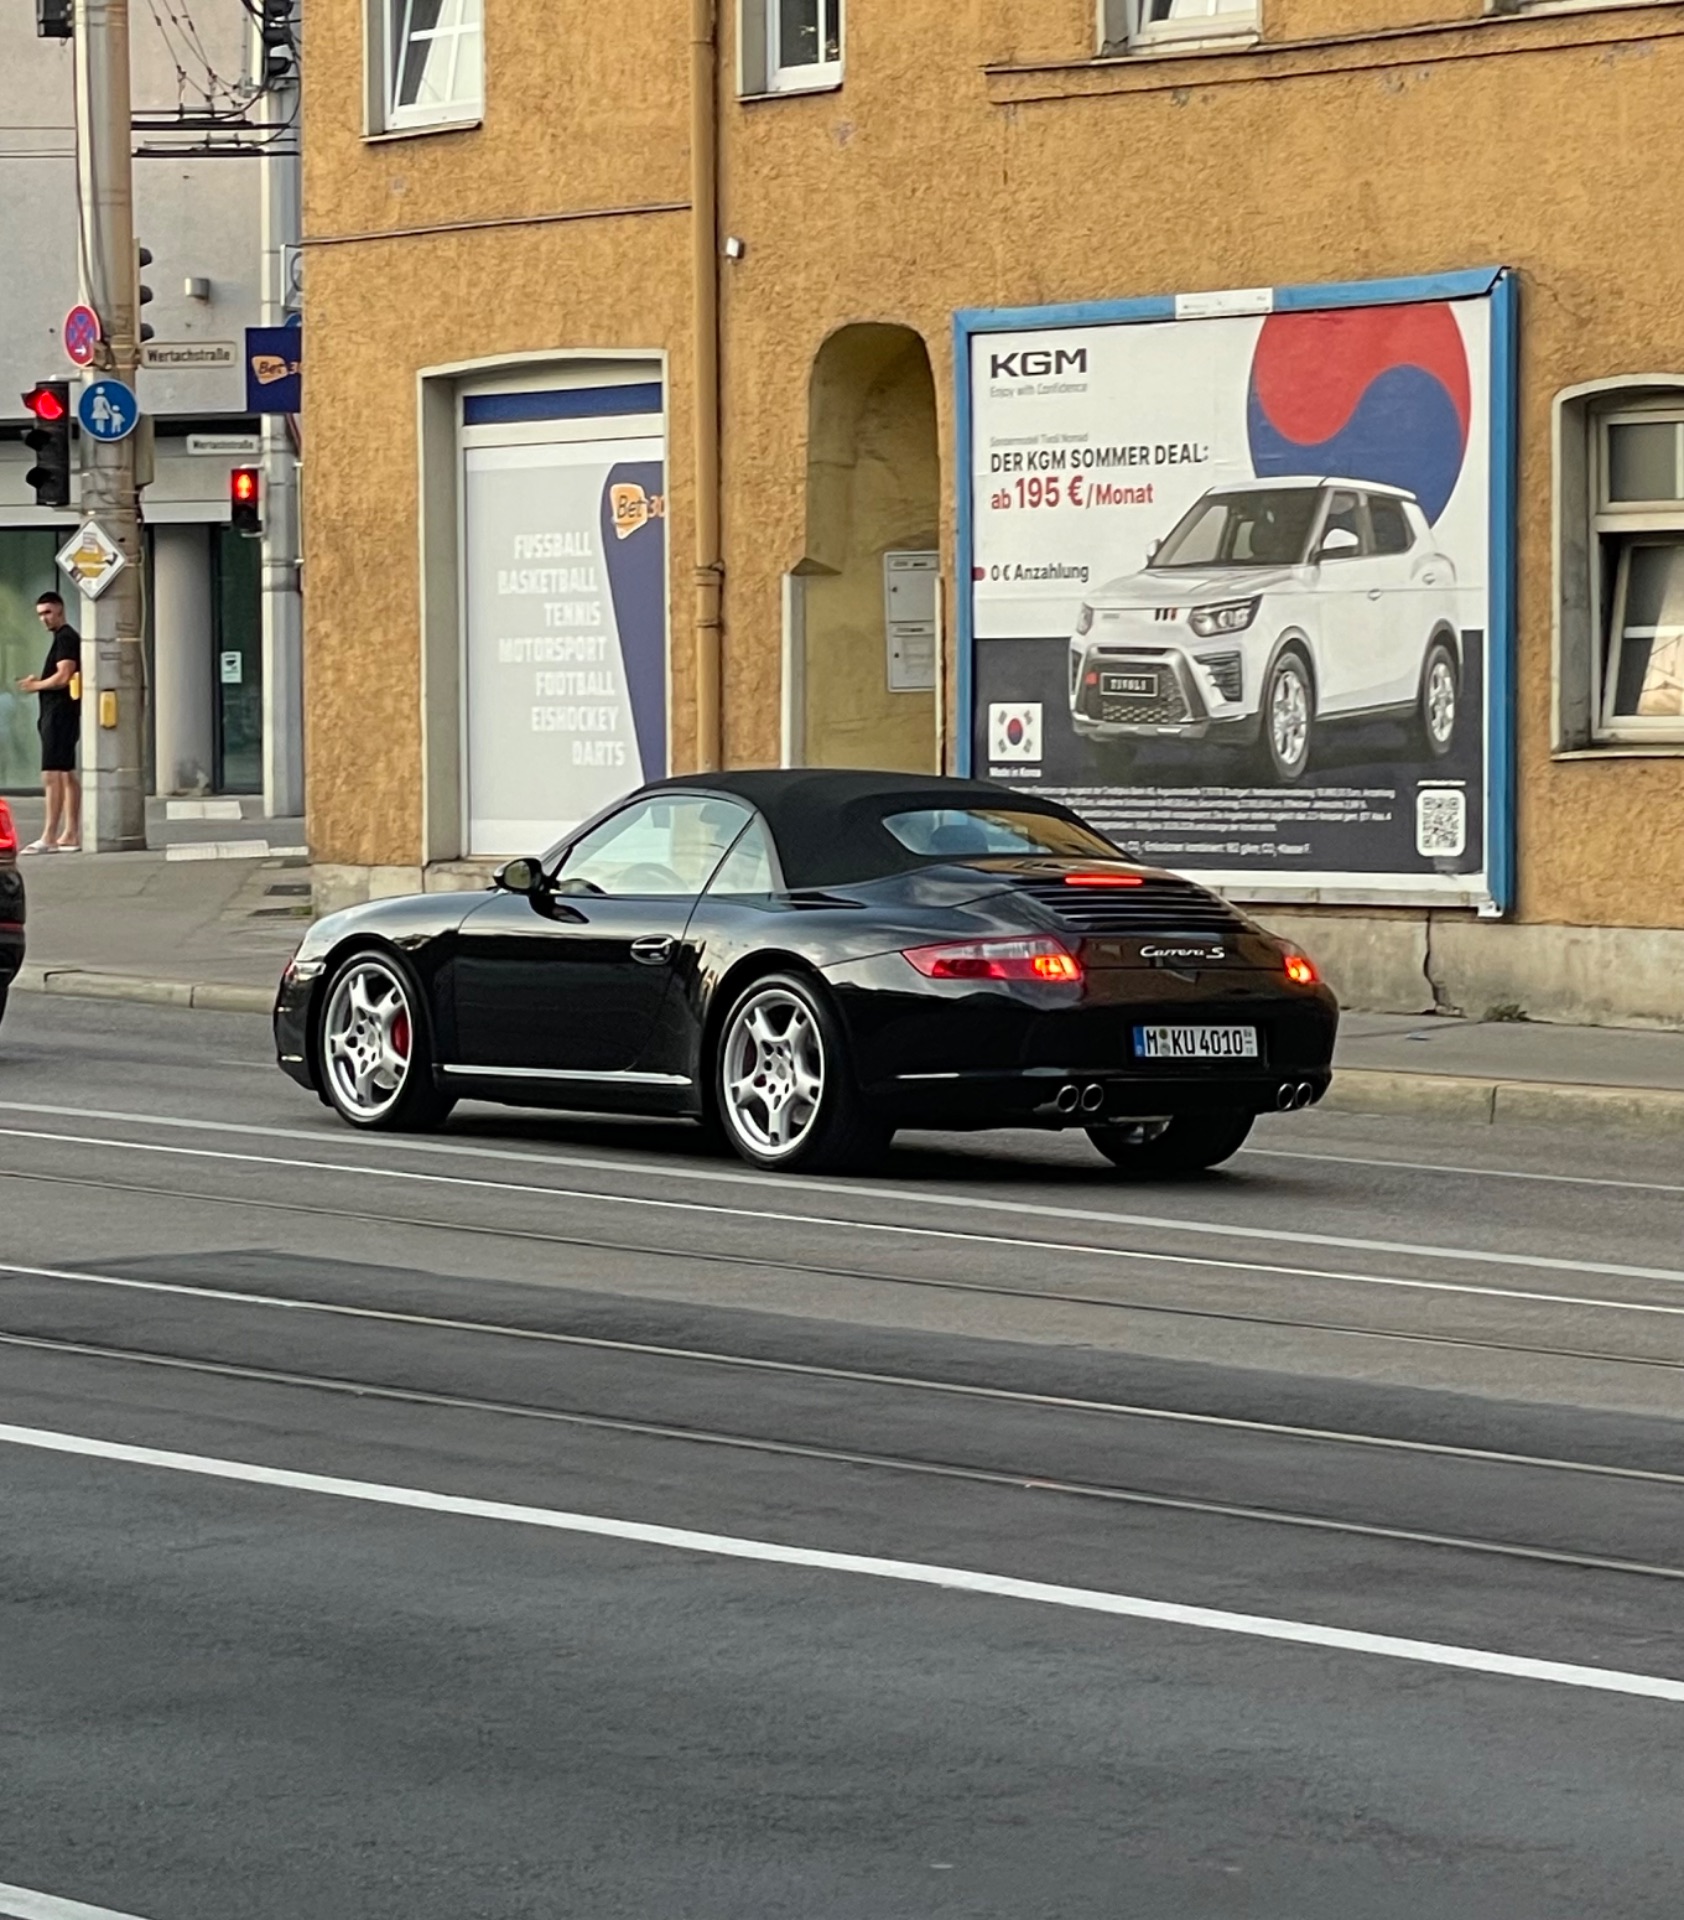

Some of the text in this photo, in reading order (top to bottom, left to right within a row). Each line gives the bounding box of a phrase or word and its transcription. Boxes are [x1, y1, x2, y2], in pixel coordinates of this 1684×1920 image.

[148, 347, 230, 362] Wertachstraße
[990, 347, 1087, 379] KGM
[991, 443, 1209, 473] DER KGM SOMMER DEAL:
[991, 488, 1011, 510] ab
[1015, 476, 1060, 509] 195
[514, 531, 592, 560] FUSSBALL
[498, 567, 598, 594] BASKETBALL
[991, 565, 999, 581] 0
[1014, 563, 1089, 582] Anzahlung
[544, 601, 600, 627] TENNIS
[499, 635, 607, 663] MOTORSPORT
[536, 670, 616, 696] FOOTBALL
[531, 705, 619, 732] EISHOCKEY
[572, 740, 625, 766] DARTS
[1140, 945, 1225, 959] Carrera S
[1146, 1029, 1159, 1055] M
[1171, 1029, 1196, 1055] KU
[1199, 1029, 1243, 1056] 4010
